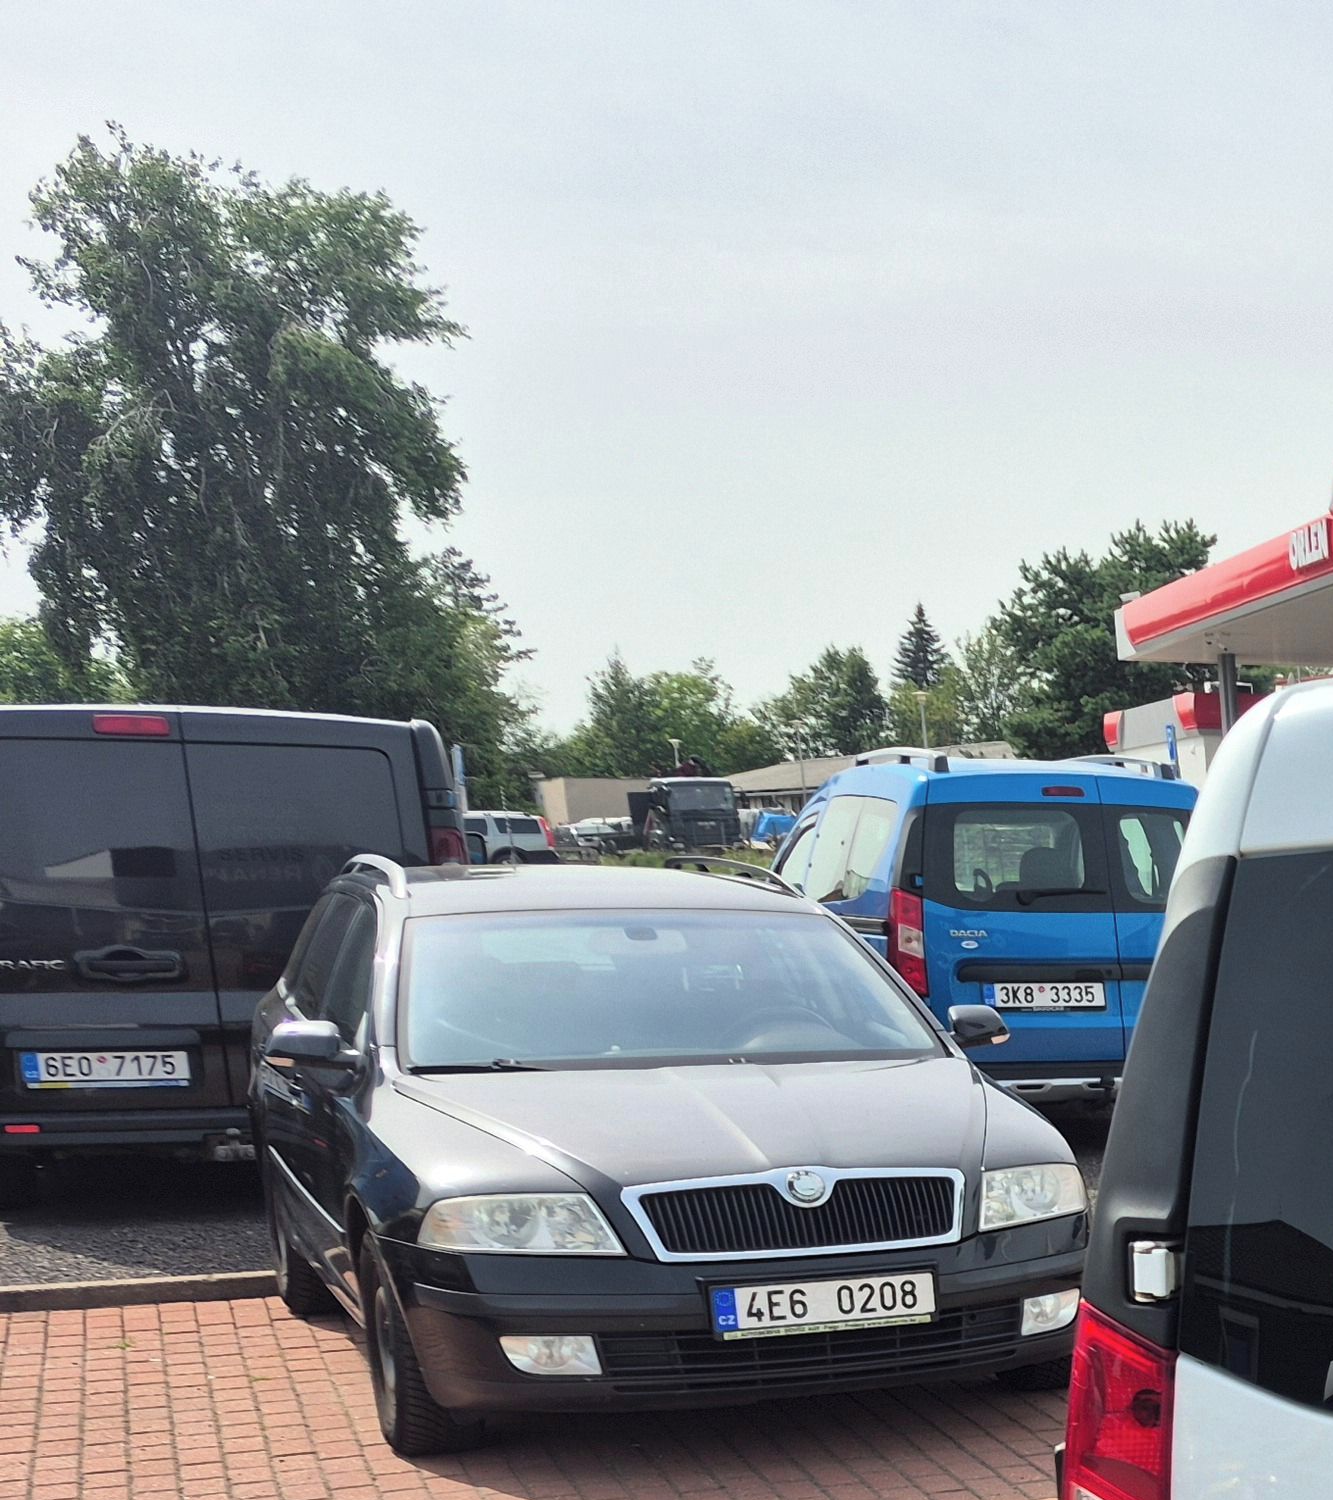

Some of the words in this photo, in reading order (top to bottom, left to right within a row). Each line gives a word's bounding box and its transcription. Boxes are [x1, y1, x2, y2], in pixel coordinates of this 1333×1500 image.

[1288, 518, 1329, 571] ORLEN
[950, 929, 988, 937] DACIA
[0, 960, 65, 970] RAFIC
[999, 986, 1035, 1004] 3K8
[1050, 985, 1096, 1004] 3335
[112, 1055, 176, 1076] 7175
[746, 1288, 809, 1322] 4E6
[836, 1279, 918, 1315] 0208
[718, 1314, 737, 1325] CZ
